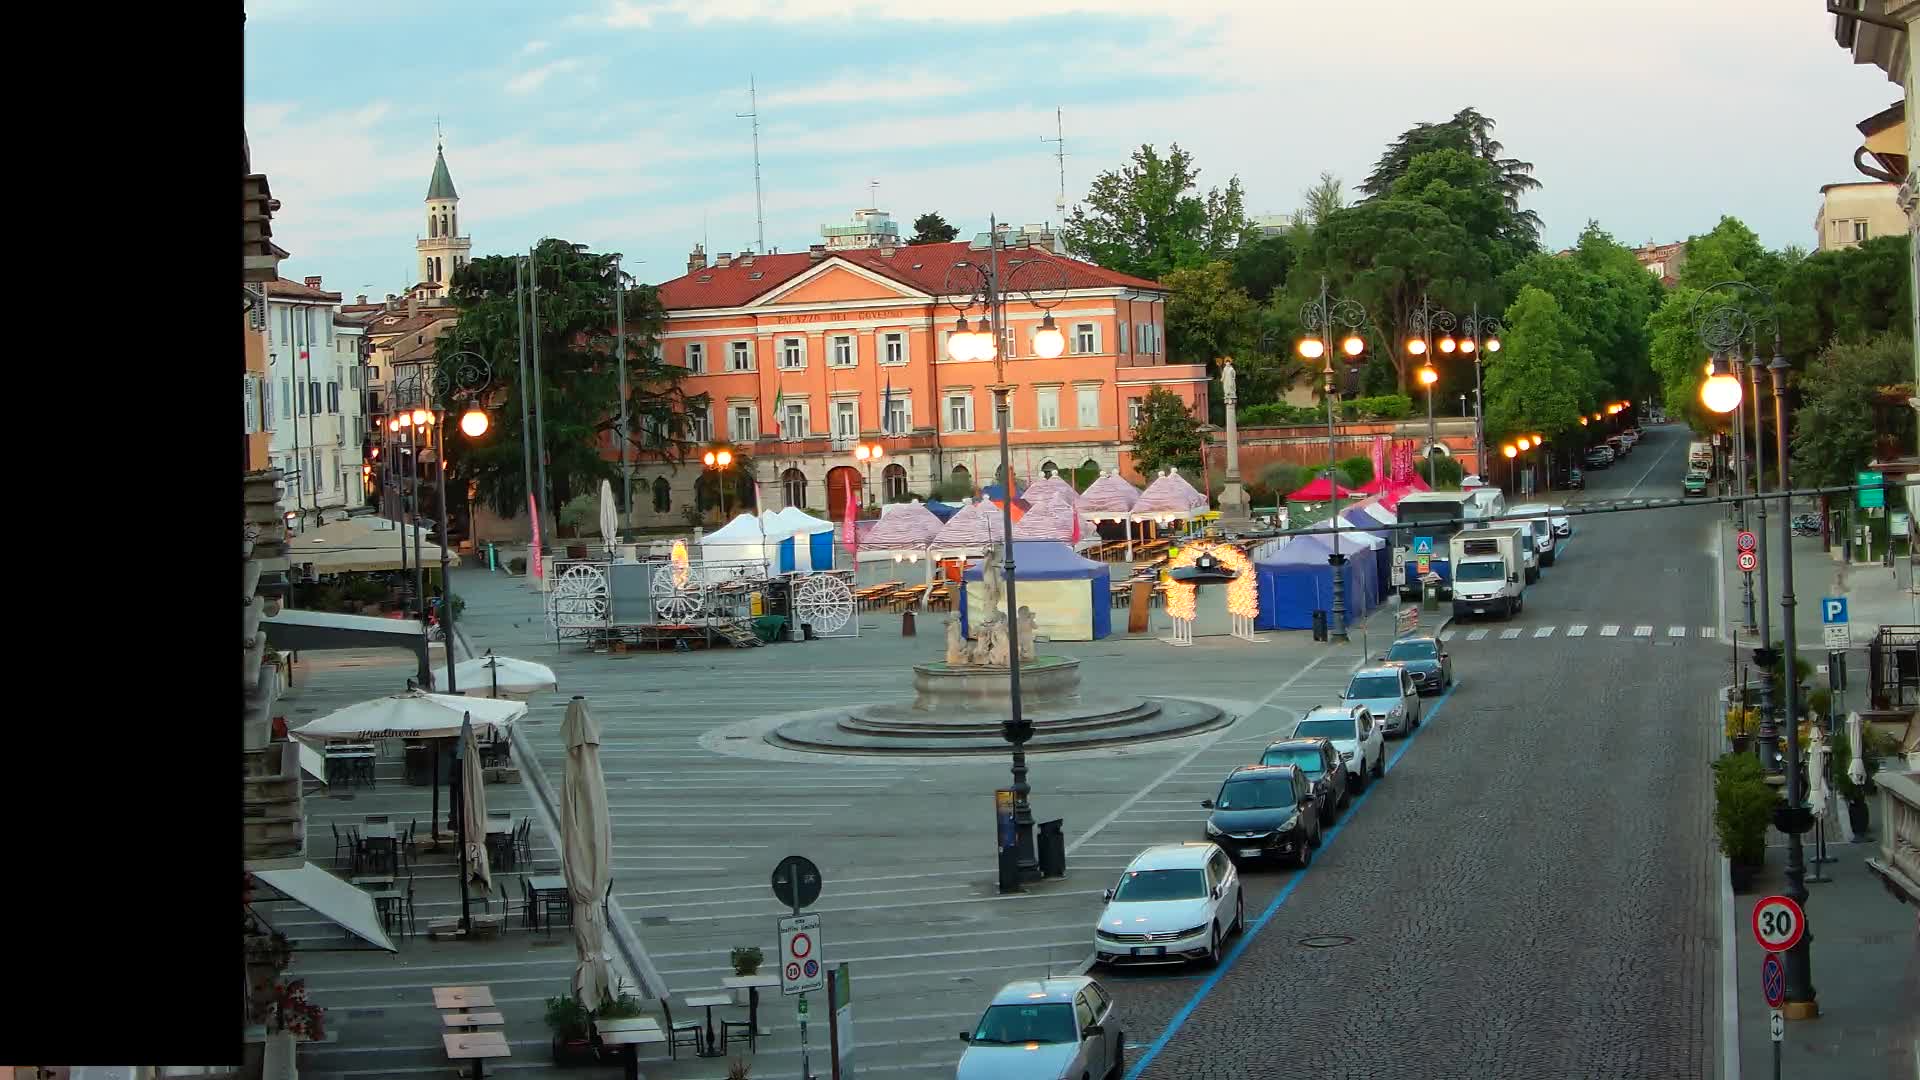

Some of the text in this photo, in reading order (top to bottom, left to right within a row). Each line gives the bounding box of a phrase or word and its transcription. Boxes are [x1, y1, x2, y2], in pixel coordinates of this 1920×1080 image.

[1742, 556, 1752, 565] 20
[1827, 601, 1842, 621] P
[1762, 911, 1791, 936] 30
